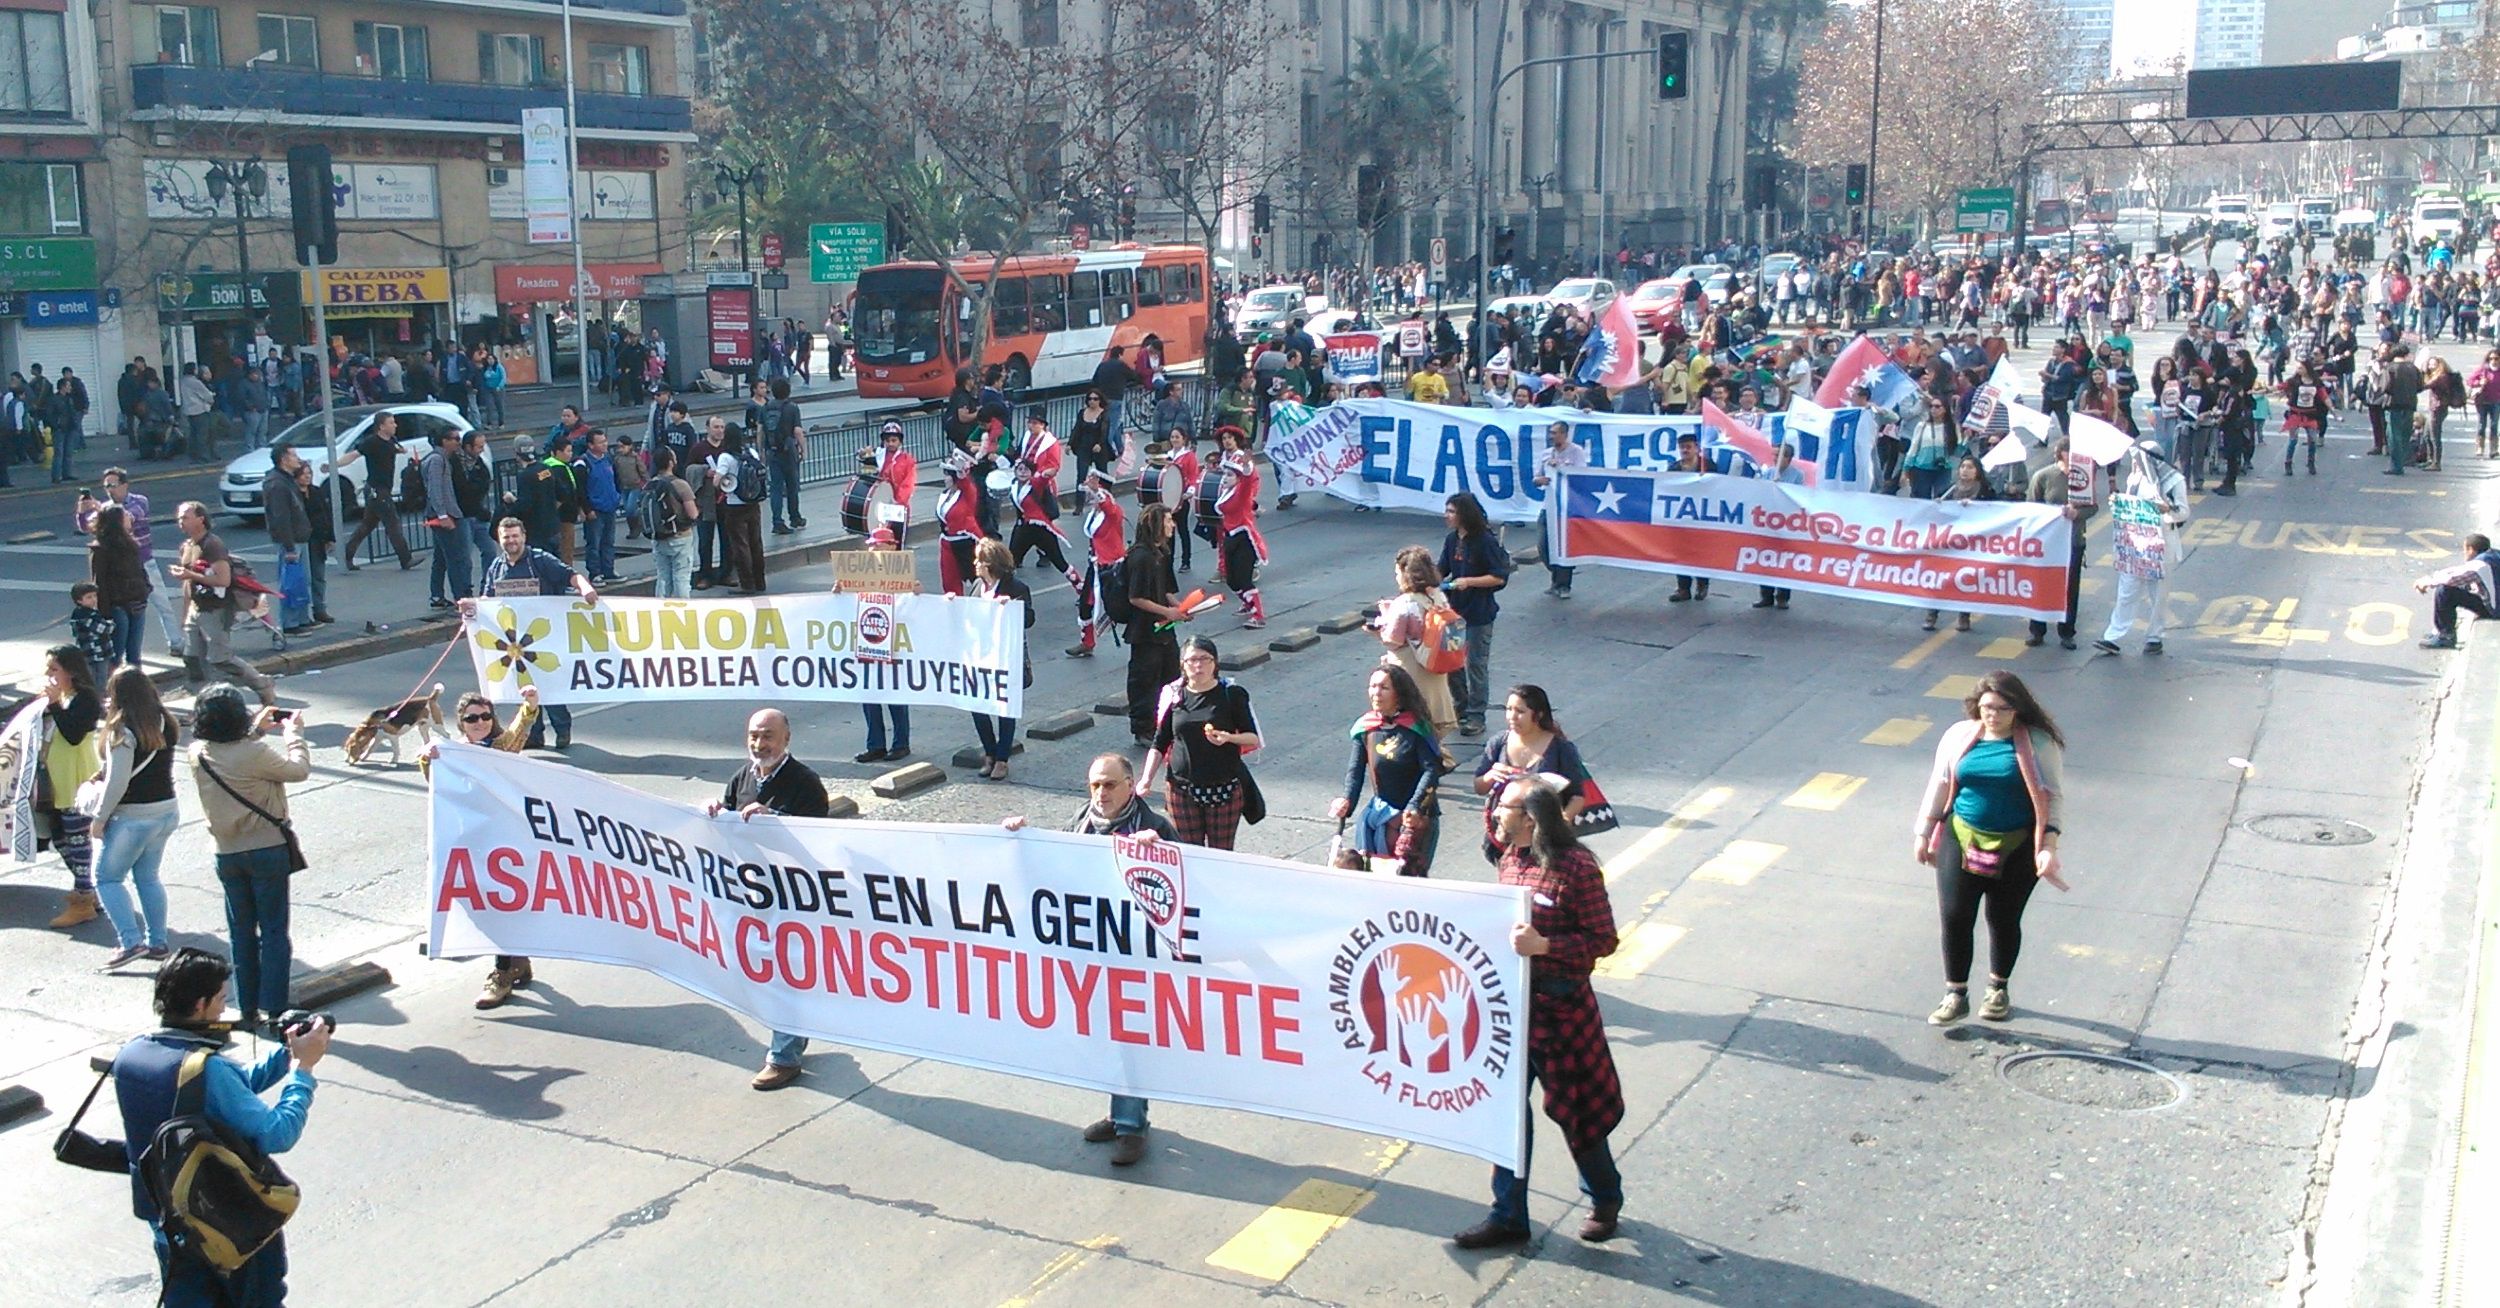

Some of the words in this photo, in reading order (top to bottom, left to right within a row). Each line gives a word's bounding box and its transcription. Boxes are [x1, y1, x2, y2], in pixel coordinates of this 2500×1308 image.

[328, 270, 425, 281] CALZADOS
[330, 283, 426, 302] BEBA
[58, 301, 89, 314] entel
[1271, 406, 1359, 464] COMUNAL
[1657, 495, 1744, 525] TALM
[1751, 505, 1861, 543] tod@s
[1865, 526, 1887, 547] a
[1891, 519, 1918, 550] la
[1923, 522, 2044, 558] Moneda
[880, 579, 913, 590] MISERIA
[1736, 546, 1812, 572] para
[1819, 552, 1952, 587] refundar
[1954, 566, 2033, 599] Chile
[566, 602, 790, 653] ÑUÑOA
[570, 655, 760, 690] ASAMBLEA
[772, 656, 1009, 703] CONSTITUYENTE
[1117, 839, 1178, 867] PELIGRO
[524, 796, 574, 845] EL
[575, 808, 694, 883] PODER
[695, 845, 853, 918] RESIDE
[863, 873, 933, 927] EN
[947, 880, 1016, 938] LA
[1031, 888, 1202, 965] GENTE
[437, 847, 727, 971] ASAMBLEA
[735, 916, 1304, 1066] CONSTITUYENTE
[1328, 918, 1385, 1050] ASAMBLEA
[1388, 910, 1512, 1079] CONSTITUYENTE
[1361, 1060, 1392, 1094] LA
[1399, 1077, 1492, 1113] FLORIDA
